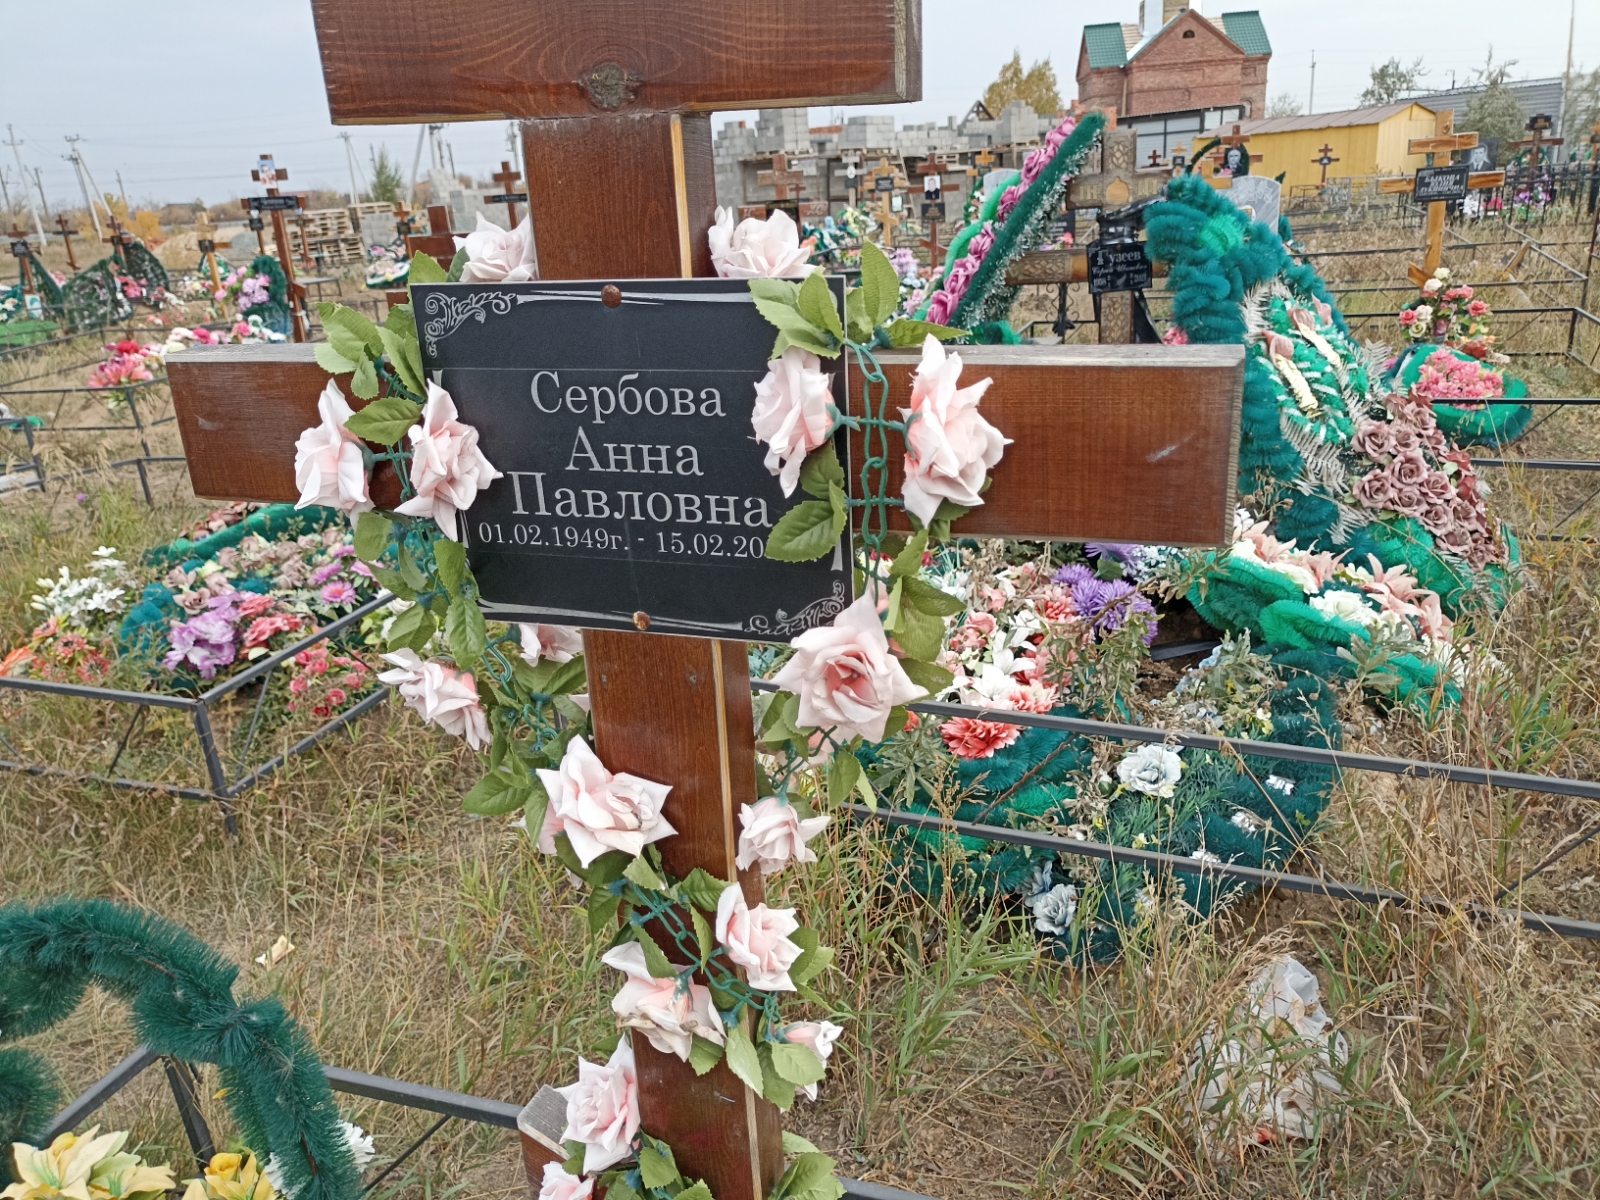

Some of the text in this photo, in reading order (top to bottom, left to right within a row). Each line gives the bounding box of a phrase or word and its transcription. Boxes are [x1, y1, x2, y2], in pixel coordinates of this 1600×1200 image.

[1096, 249, 1142, 267] Гузеев
[530, 371, 727, 424] Сербова
[564, 425, 705, 476] Анна
[506, 471, 773, 528] Павловна
[478, 522, 630, 551] 01.02.1949г.
